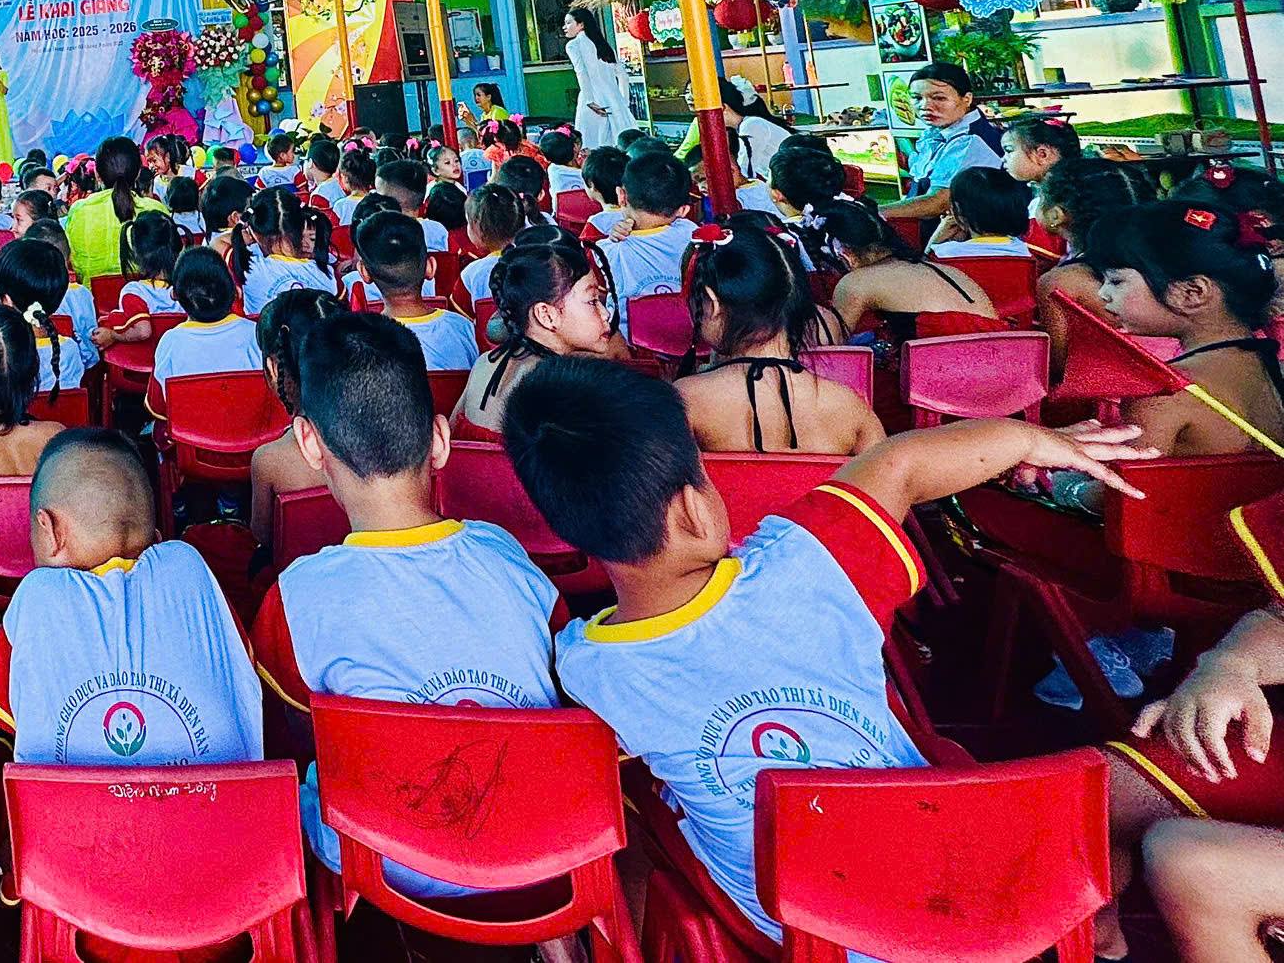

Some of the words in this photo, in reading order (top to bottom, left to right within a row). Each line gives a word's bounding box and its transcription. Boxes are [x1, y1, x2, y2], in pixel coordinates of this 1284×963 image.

[40, 1, 75, 19] KHAI
[16, 27, 41, 43] NĂM
[44, 27, 70, 41] HỌC:
[72, 25, 99, 38] 2025
[109, 22, 136, 34] 2026
[94, 670, 109, 690] VÀ
[149, 674, 167, 697] THỊ
[467, 669, 488, 687] TẠO
[490, 673, 509, 695] THỊ
[750, 687, 780, 706] TẠO
[780, 686, 805, 705] THỊ
